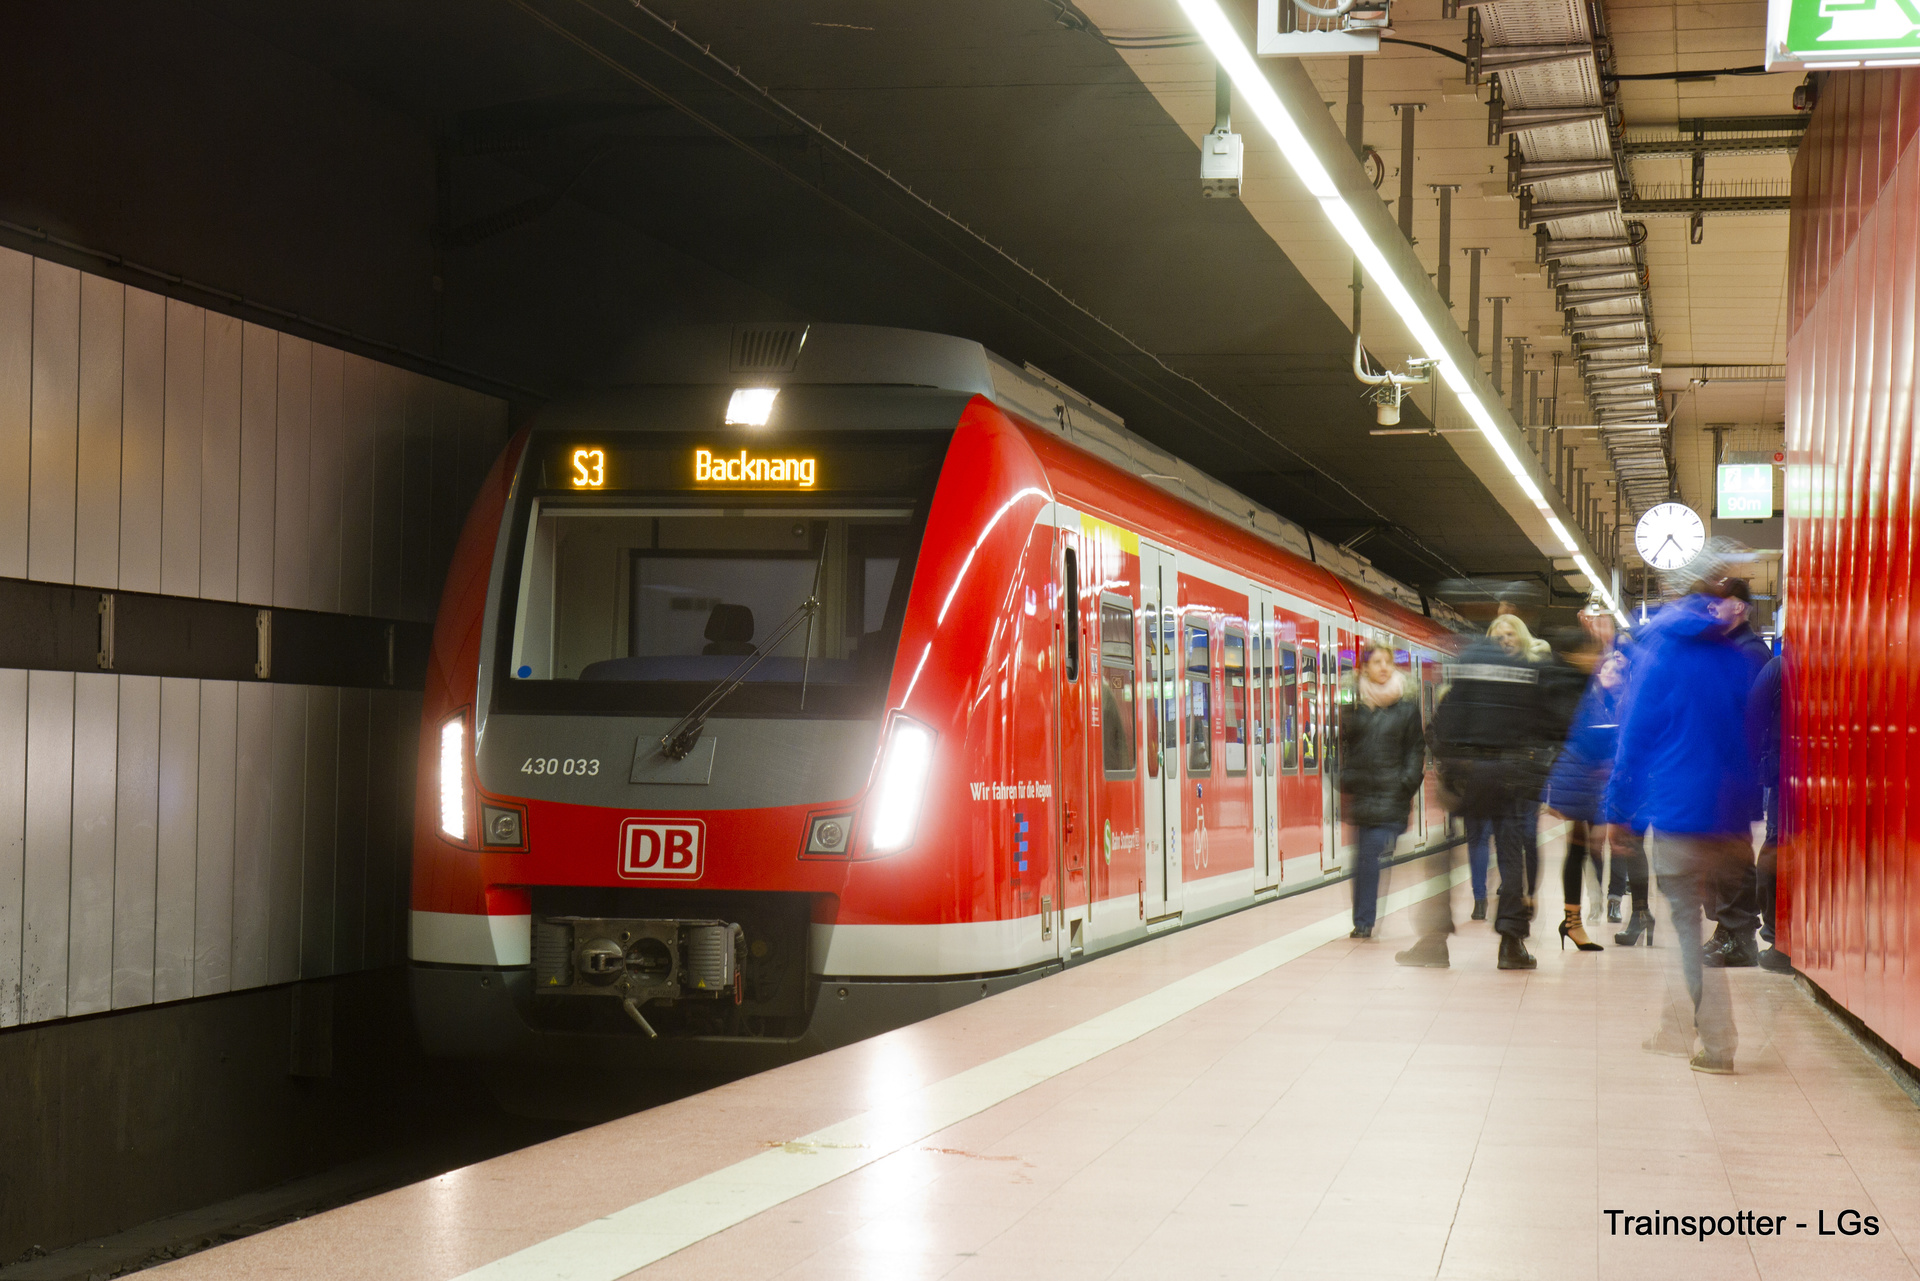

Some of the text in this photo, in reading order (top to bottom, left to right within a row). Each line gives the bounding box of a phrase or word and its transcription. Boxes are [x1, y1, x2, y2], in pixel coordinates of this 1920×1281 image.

[573, 450, 815, 486] S3 Backnang
[1727, 496, 1761, 511] 90m
[521, 758, 600, 776] 430 033
[970, 780, 1052, 802] Wir fahren für die Region
[630, 829, 693, 869] DB
